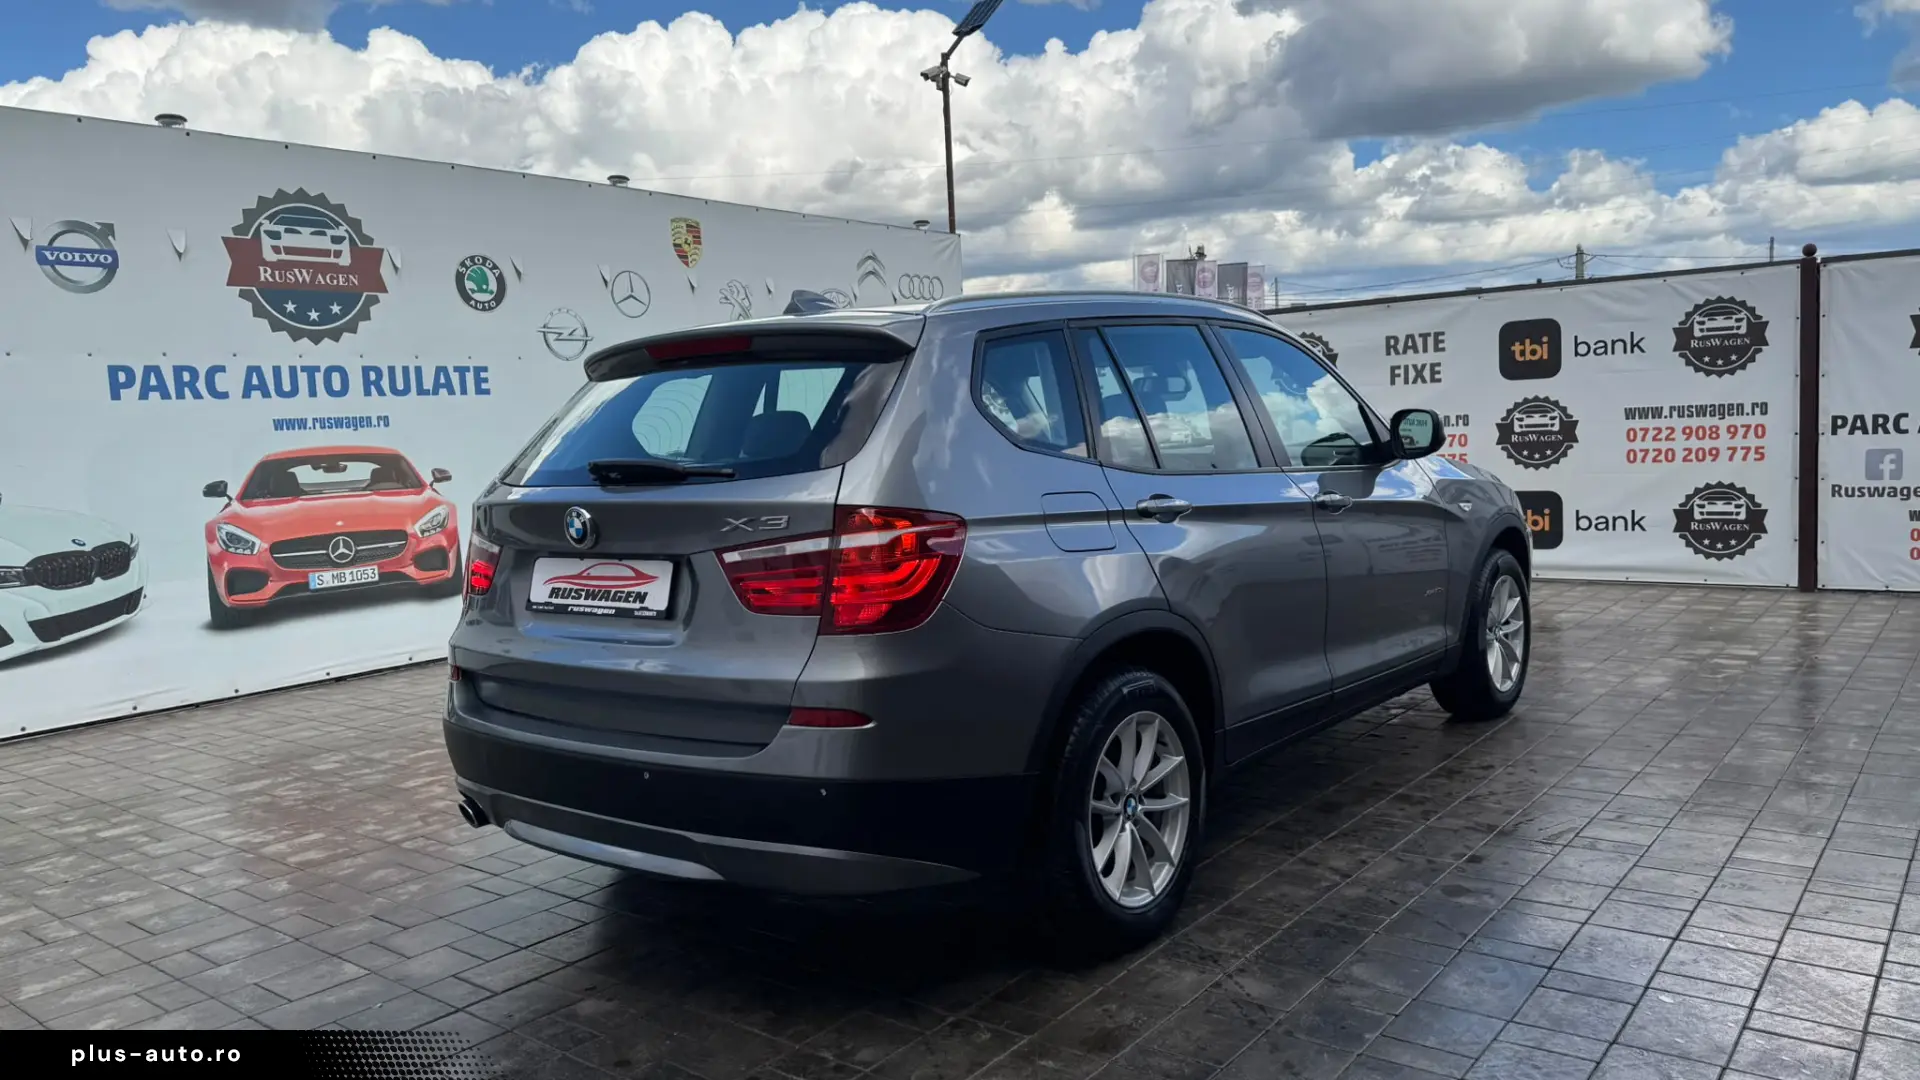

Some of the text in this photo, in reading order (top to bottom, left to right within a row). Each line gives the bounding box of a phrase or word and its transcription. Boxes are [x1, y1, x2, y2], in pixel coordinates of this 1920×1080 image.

[41, 250, 113, 264] VOLVO
[469, 300, 497, 310] AUTO
[1385, 331, 1446, 356] RATE
[1511, 331, 1647, 362] tbi bank
[107, 364, 492, 401] PARC AUTO RULATE
[1390, 362, 1442, 386] FIXE
[1624, 401, 1769, 421] www.ruswagen.ro
[272, 415, 390, 432] www.ruswagen.ro
[1625, 423, 1767, 443] 0722 908 970
[1831, 412, 1910, 436] PARC
[1447, 433, 1469, 448] 70
[1625, 445, 1766, 464] 0720 209 775
[720, 515, 791, 533] X3
[1524, 508, 1647, 532] bi bank
[548, 586, 649, 605] RUSWAGEN
